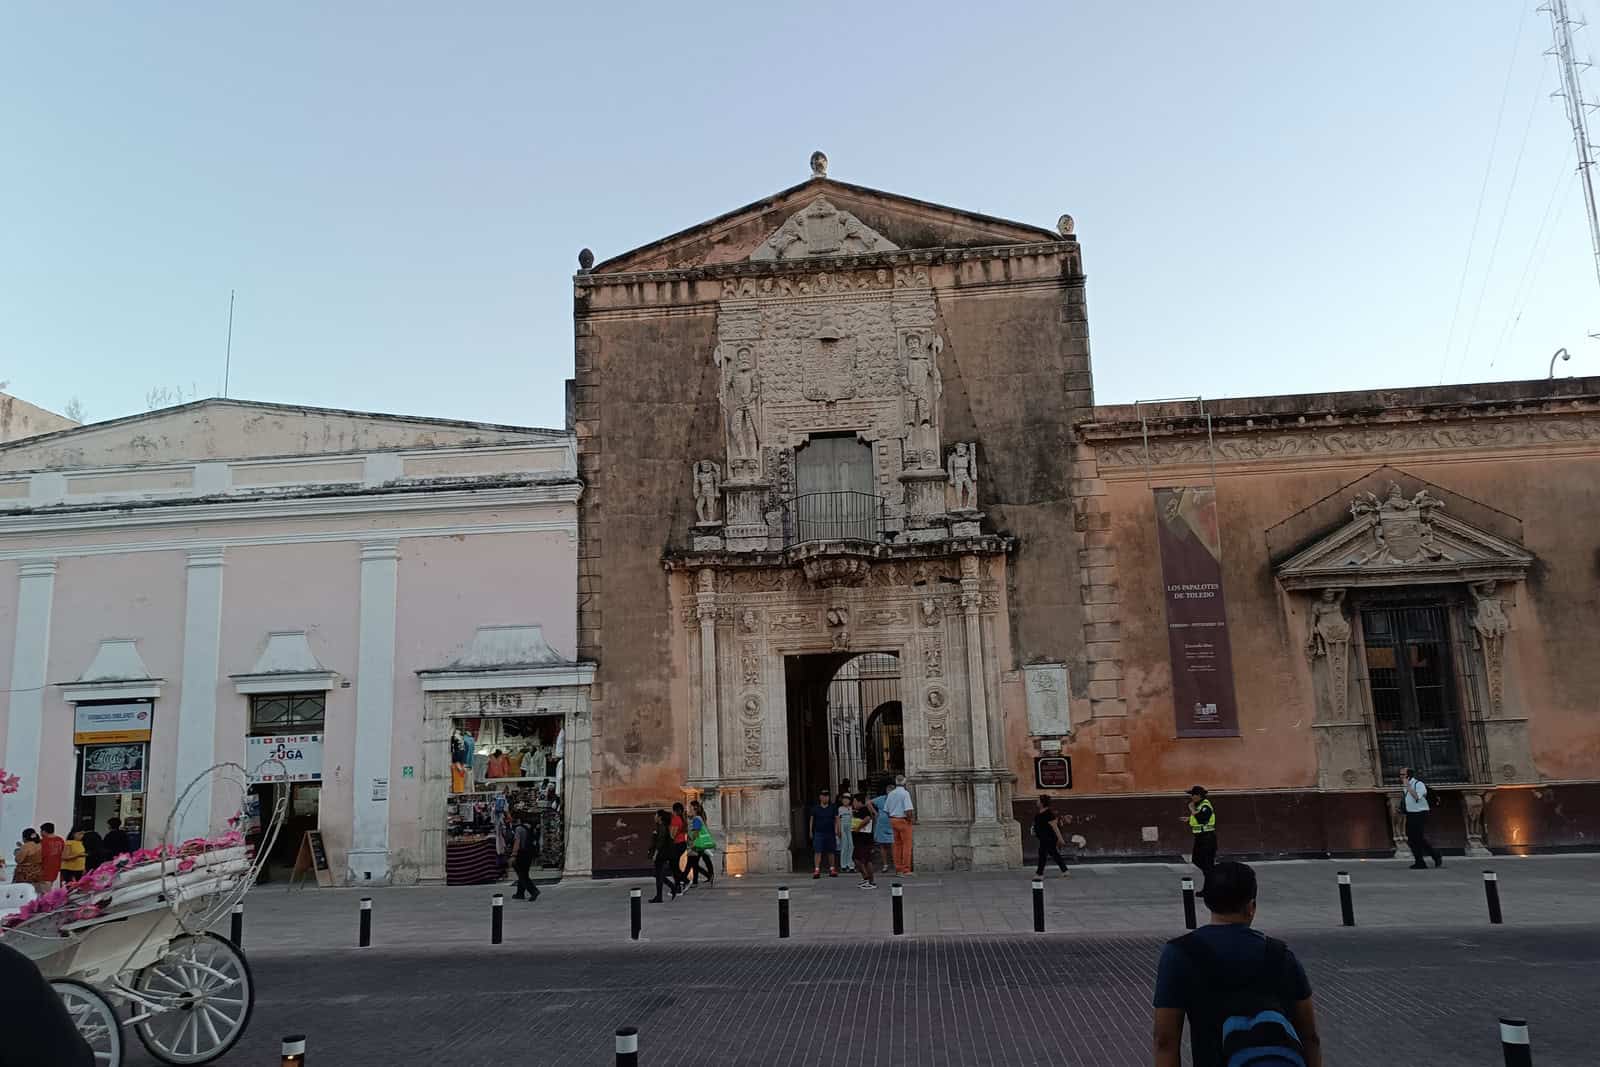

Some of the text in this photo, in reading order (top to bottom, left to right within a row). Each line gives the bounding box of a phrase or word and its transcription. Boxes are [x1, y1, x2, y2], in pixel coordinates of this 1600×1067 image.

[1167, 583, 1219, 592] LOS PAPALOTES
[1185, 591, 1215, 599] TOLEDO
